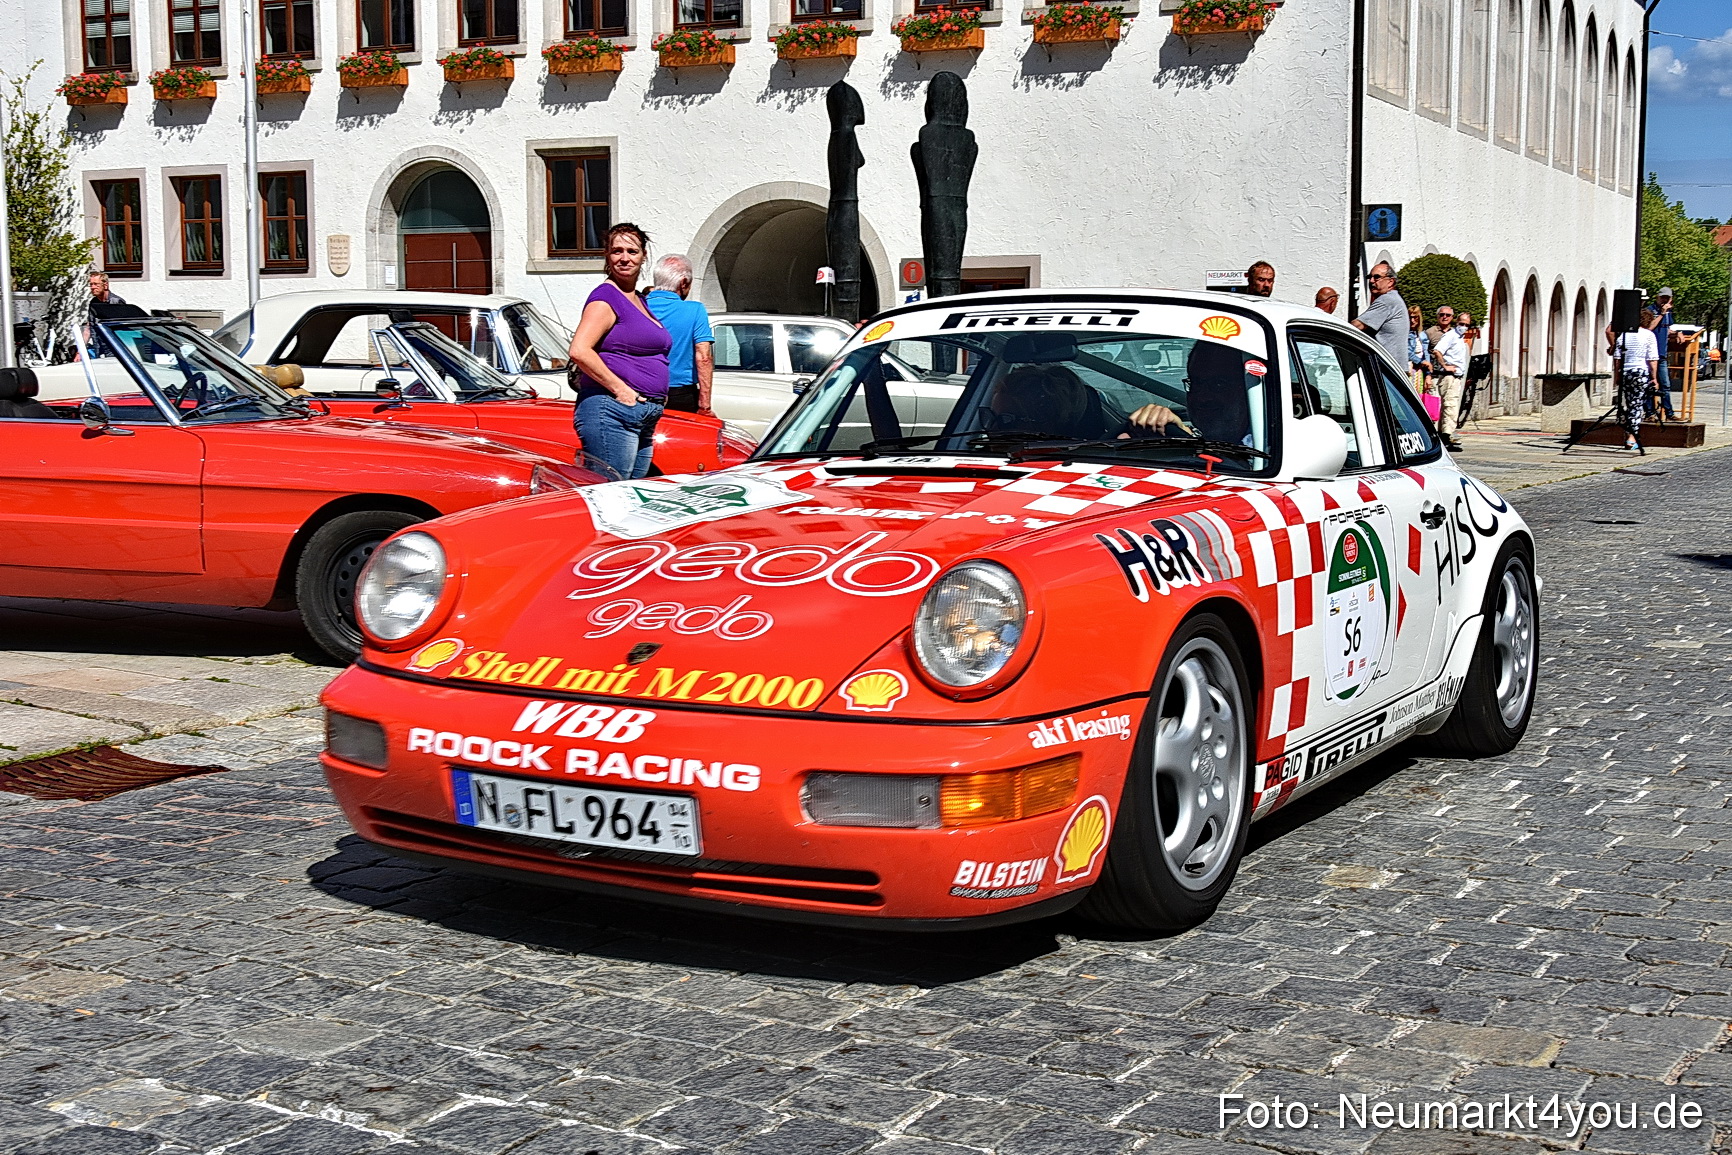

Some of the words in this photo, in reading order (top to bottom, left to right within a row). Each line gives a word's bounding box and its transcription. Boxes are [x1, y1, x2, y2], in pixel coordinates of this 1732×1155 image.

[1208, 271, 1243, 279] NEUMARKT
[939, 307, 1140, 331] PIRELLI
[1398, 432, 1425, 456] RECARO
[777, 506, 936, 521] FOLIATEC
[1328, 503, 1385, 526] PORSCHE
[566, 531, 942, 600] gedo
[1093, 518, 1211, 603] H&R
[583, 595, 774, 641] gedo
[451, 650, 564, 686] Shell
[551, 663, 641, 696] mit
[702, 671, 825, 710] 2000
[511, 700, 658, 744] WBB
[1028, 717, 1069, 749] akf
[1066, 710, 1131, 741] leasing
[407, 727, 554, 771] ROOCK
[565, 748, 761, 793] RACING
[1303, 711, 1388, 783] PIRELLI
[1265, 752, 1303, 790] PAGID
[474, 779, 500, 824] N
[522, 787, 576, 835] FL
[583, 794, 662, 845] 964
[952, 856, 1049, 888] BILSTEIN
